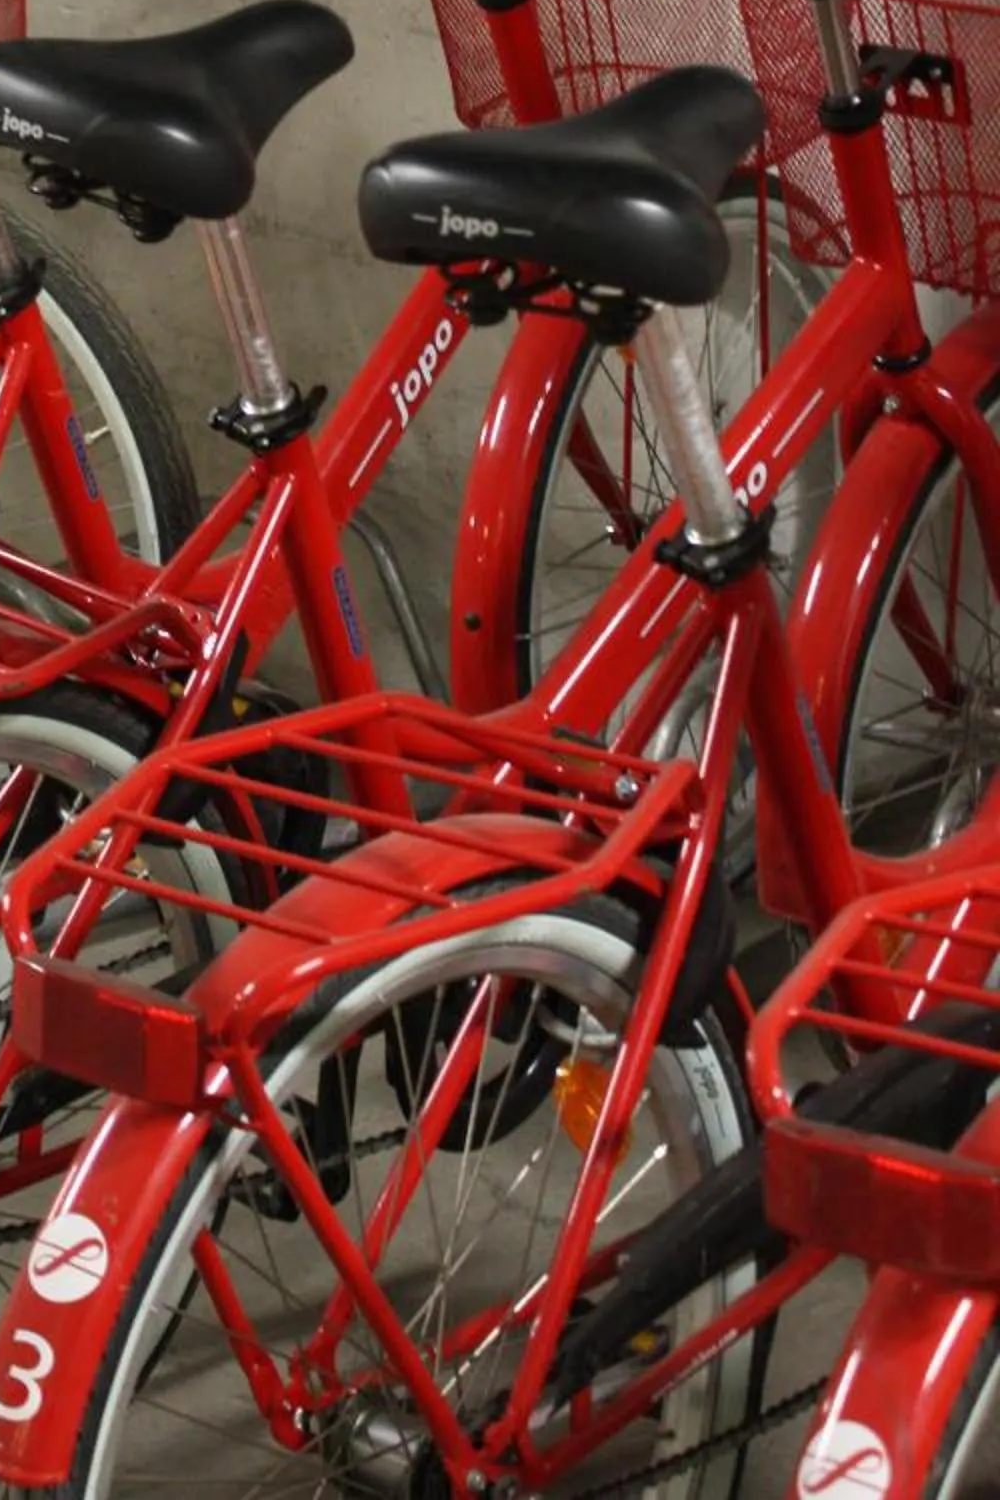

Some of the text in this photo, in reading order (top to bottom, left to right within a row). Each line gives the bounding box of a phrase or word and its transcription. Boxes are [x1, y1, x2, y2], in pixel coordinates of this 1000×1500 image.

[2, 107, 43, 139] jopo
[440, 204, 499, 239] jopo
[390, 318, 453, 430] jopo
